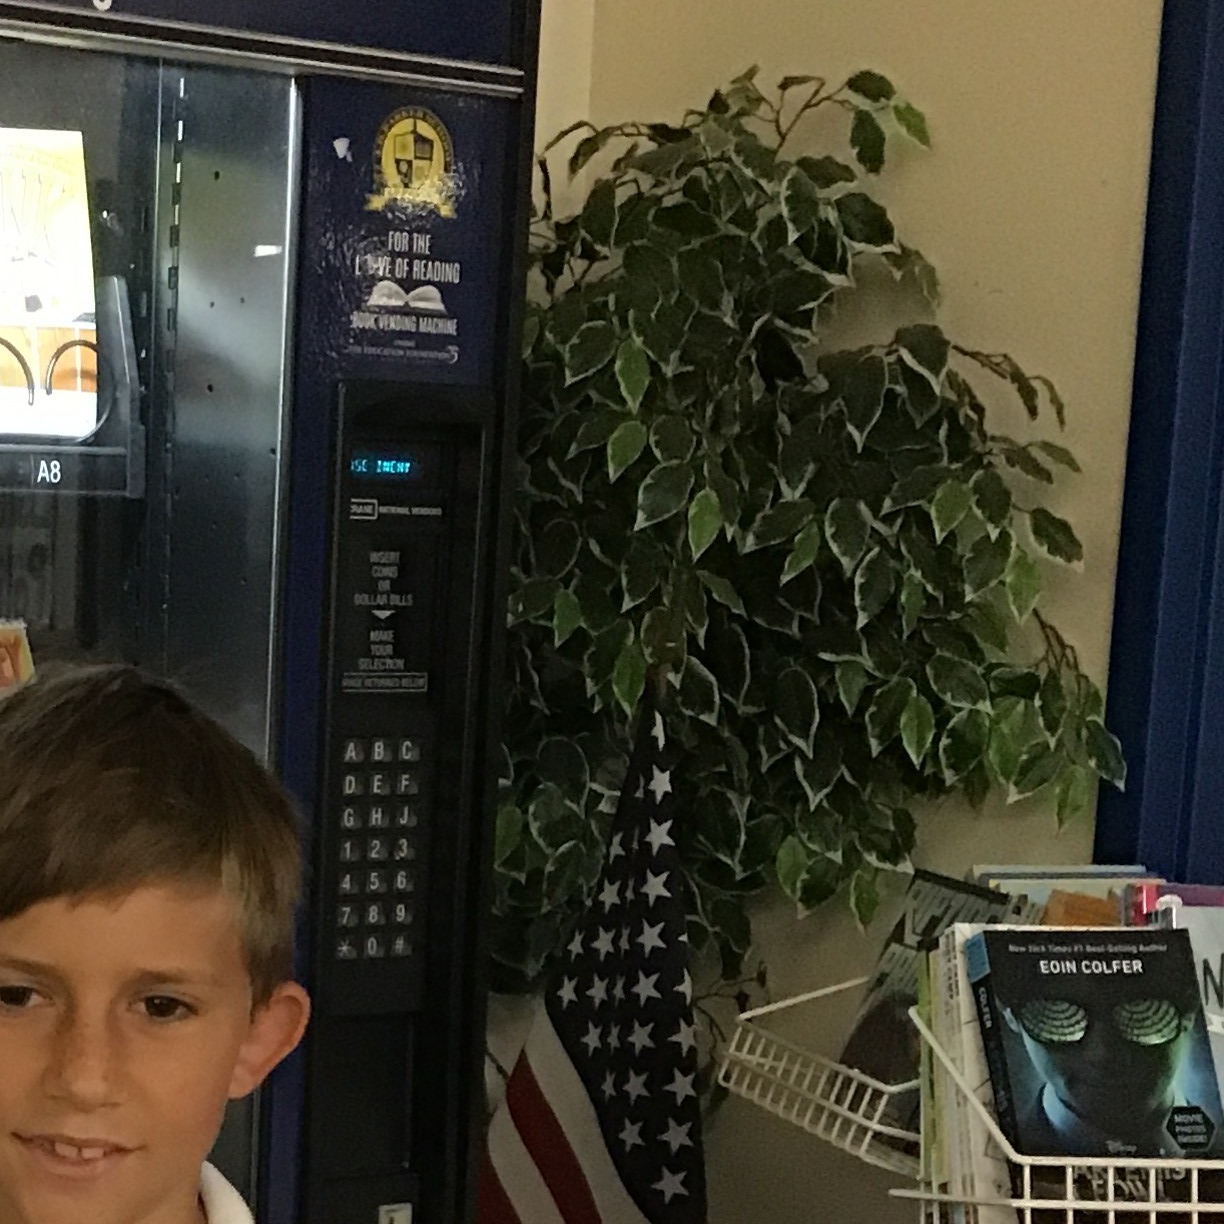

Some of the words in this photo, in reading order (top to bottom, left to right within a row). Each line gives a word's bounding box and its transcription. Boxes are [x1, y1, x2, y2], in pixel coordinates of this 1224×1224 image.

[388, 231, 409, 252] FOR
[413, 233, 431, 255] THE
[396, 258, 409, 279] OF
[413, 259, 460, 284] READING
[419, 316, 458, 336] MACHINE
[37, 460, 61, 484] A8
[344, 742, 357, 761] A
[374, 741, 384, 760] B
[402, 741, 412, 760] C
[346, 776, 355, 794] D
[374, 775, 383, 793] E
[401, 774, 410, 792] F
[344, 808, 354, 827] G
[372, 807, 382, 826] H
[399, 806, 409, 825] J
[344, 841, 351, 859] 1
[371, 840, 381, 858] 2
[398, 838, 408, 857] 3
[342, 874, 351, 891] 4
[370, 873, 379, 890] 5
[397, 871, 406, 889] 6
[342, 907, 351, 924] 7
[369, 905, 378, 922] 8
[396, 904, 405, 922] 9
[368, 937, 377, 955] 0
[1039, 960, 1076, 974] EOIN
[1082, 959, 1143, 974] COLFER
